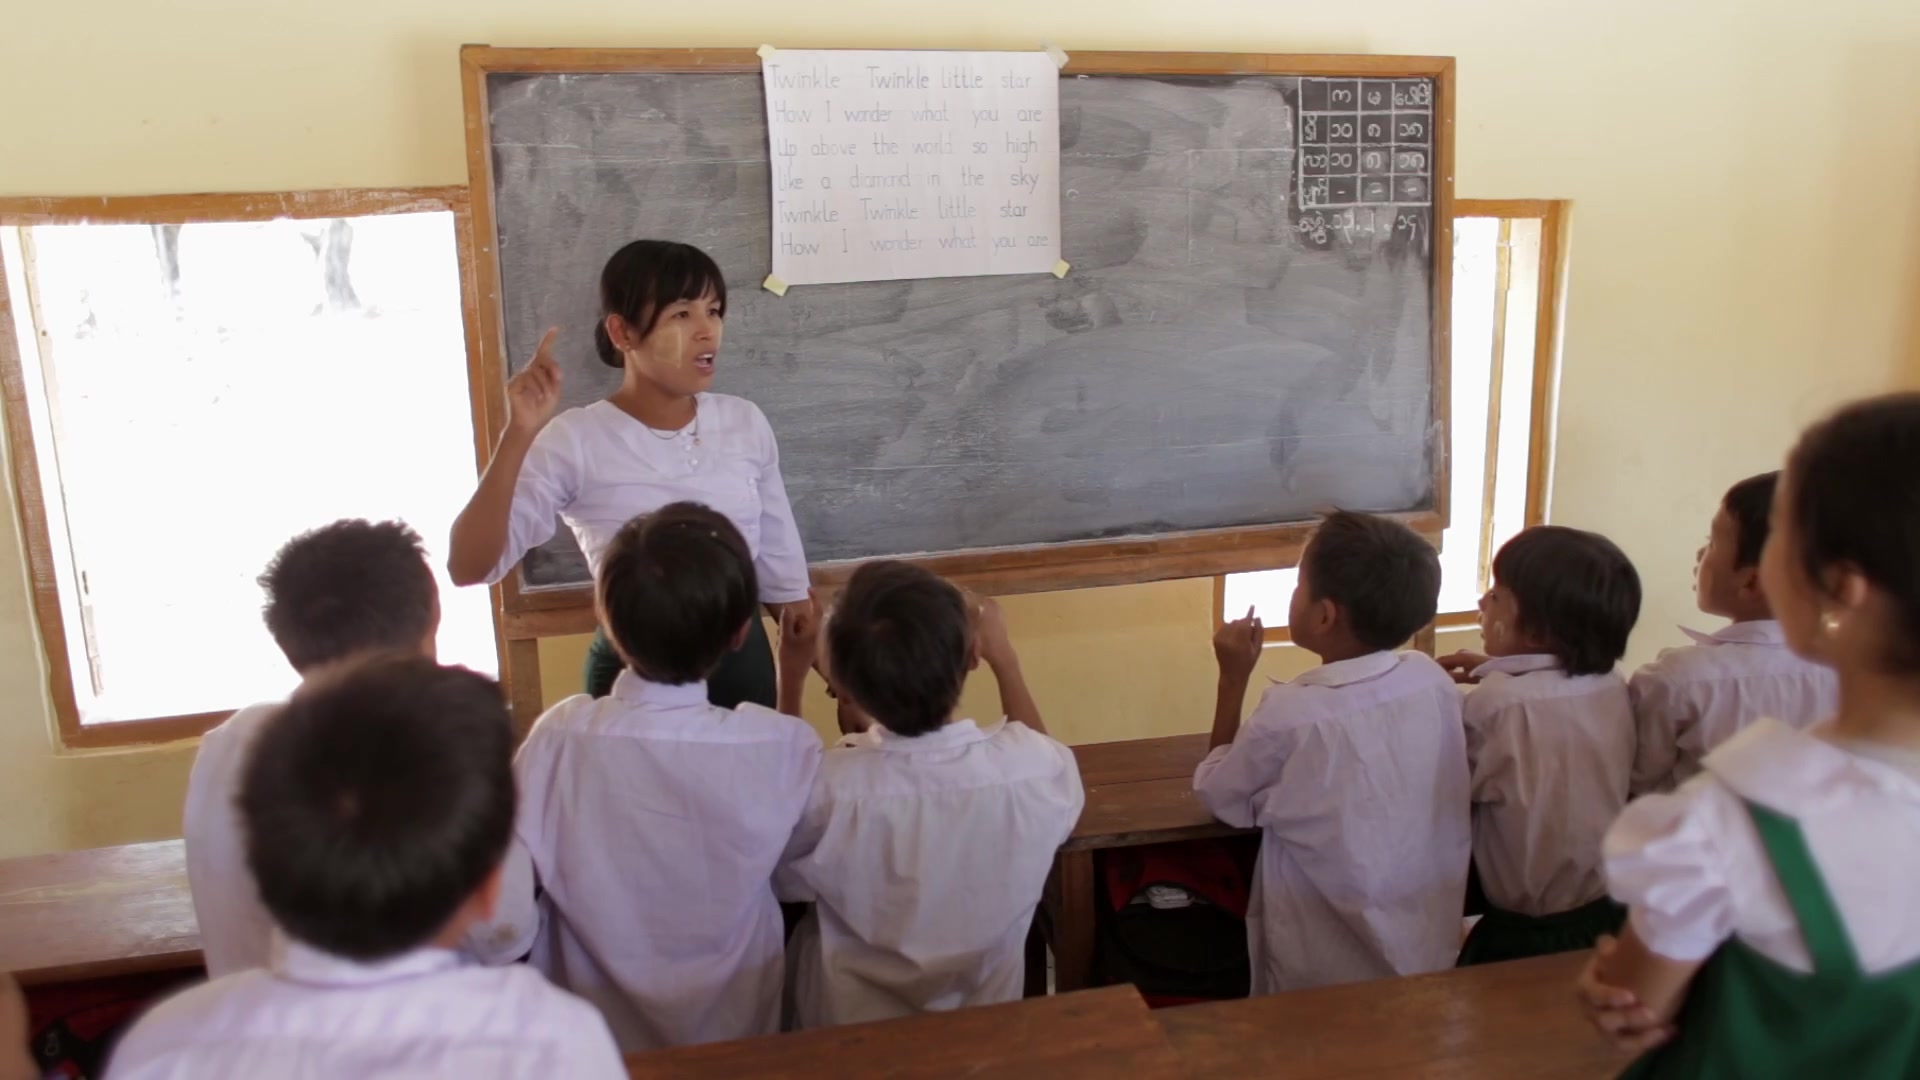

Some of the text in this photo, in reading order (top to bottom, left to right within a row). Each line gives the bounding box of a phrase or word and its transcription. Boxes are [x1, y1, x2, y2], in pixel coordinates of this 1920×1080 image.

[768, 64, 841, 89] Twinkle
[866, 65, 929, 89] Twinkle
[1001, 69, 1031, 89] star
[775, 101, 812, 123] How
[825, 100, 832, 123] I
[912, 101, 950, 122] what
[972, 109, 999, 128] you
[1017, 109, 1042, 122] are
[776, 130, 1037, 166] Up above the world so high
[821, 175, 832, 189] a
[850, 164, 911, 189] diamond
[927, 171, 941, 186] in
[961, 164, 984, 186] the
[1010, 165, 1039, 194] sky
[778, 200, 839, 223] Twinkle
[860, 197, 919, 220] Twinkle
[1000, 199, 1028, 218] star
[780, 225, 1049, 256] How I wonder what you are
